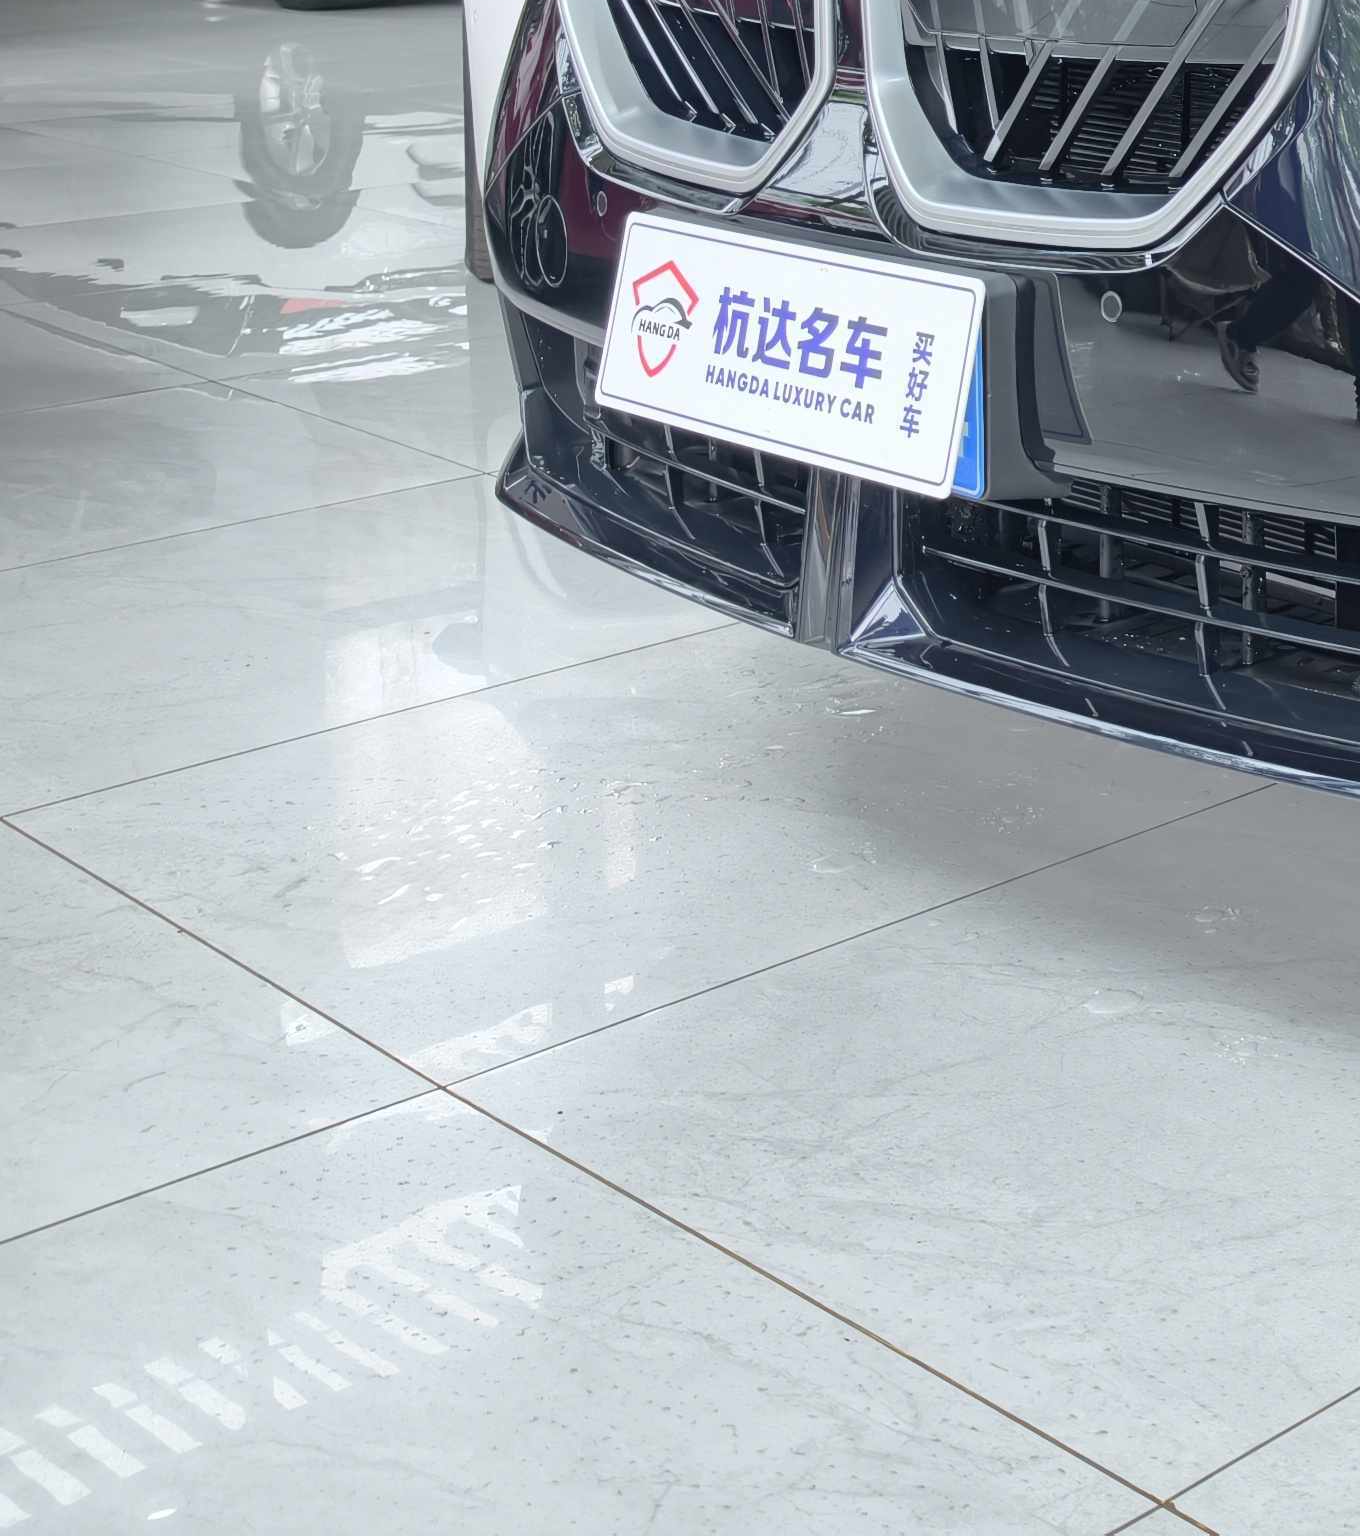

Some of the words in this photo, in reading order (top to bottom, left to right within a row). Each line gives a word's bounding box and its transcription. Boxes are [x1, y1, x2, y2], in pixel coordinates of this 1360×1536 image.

[638, 317, 668, 338] HANG
[668, 323, 681, 342] DA
[713, 286, 888, 390] 杭达名车
[705, 364, 769, 399] HANGDA
[773, 381, 837, 416] LUXURY
[840, 399, 875, 426] CAR
[899, 330, 936, 439] 买好车
